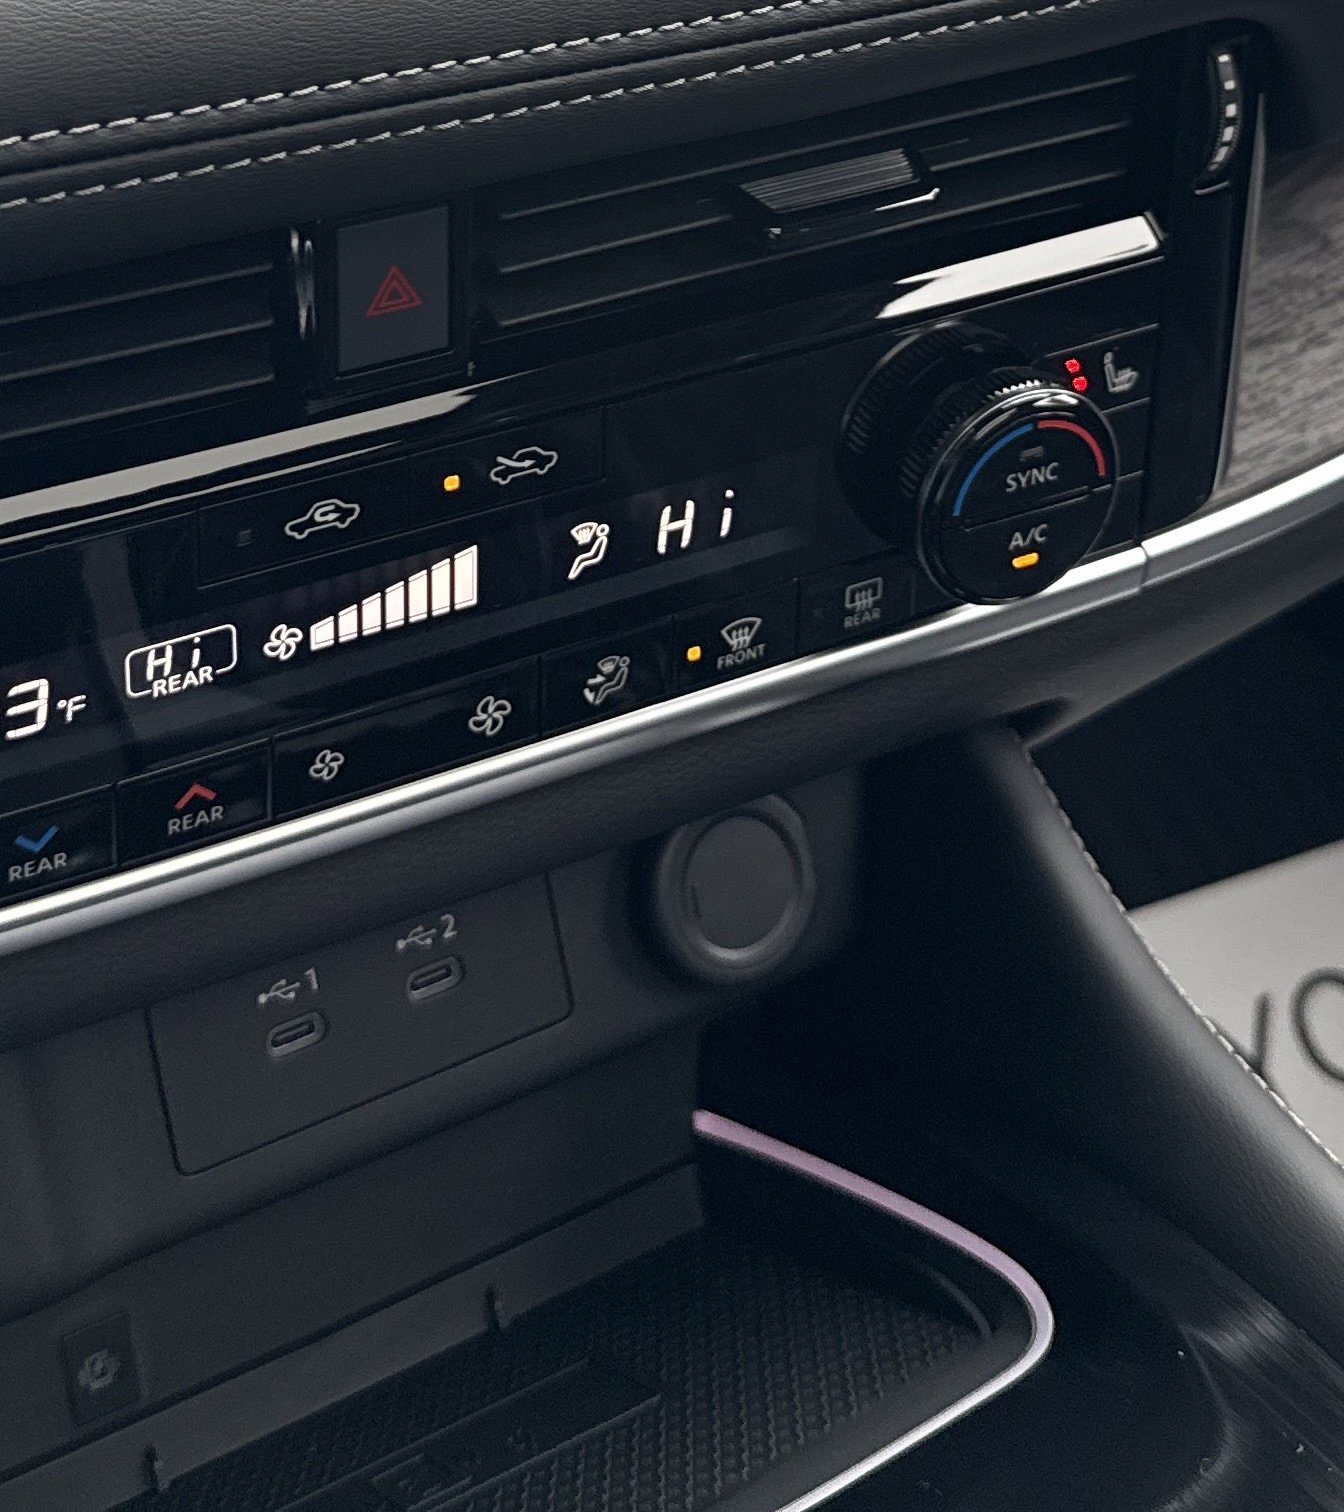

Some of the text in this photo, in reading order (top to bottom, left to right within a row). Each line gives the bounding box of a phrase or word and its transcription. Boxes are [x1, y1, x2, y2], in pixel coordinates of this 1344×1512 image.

[1006, 463, 1058, 492] SYNC
[657, 490, 734, 555] Hi
[1008, 524, 1048, 551] A/C
[843, 607, 881, 629] REAR
[146, 637, 202, 680] Hi
[717, 643, 765, 670] FRONT
[152, 666, 214, 697] REAR
[167, 806, 224, 836] REAR
[8, 854, 67, 883] REAR
[439, 913, 458, 939] 2
[305, 967, 320, 991] 1
